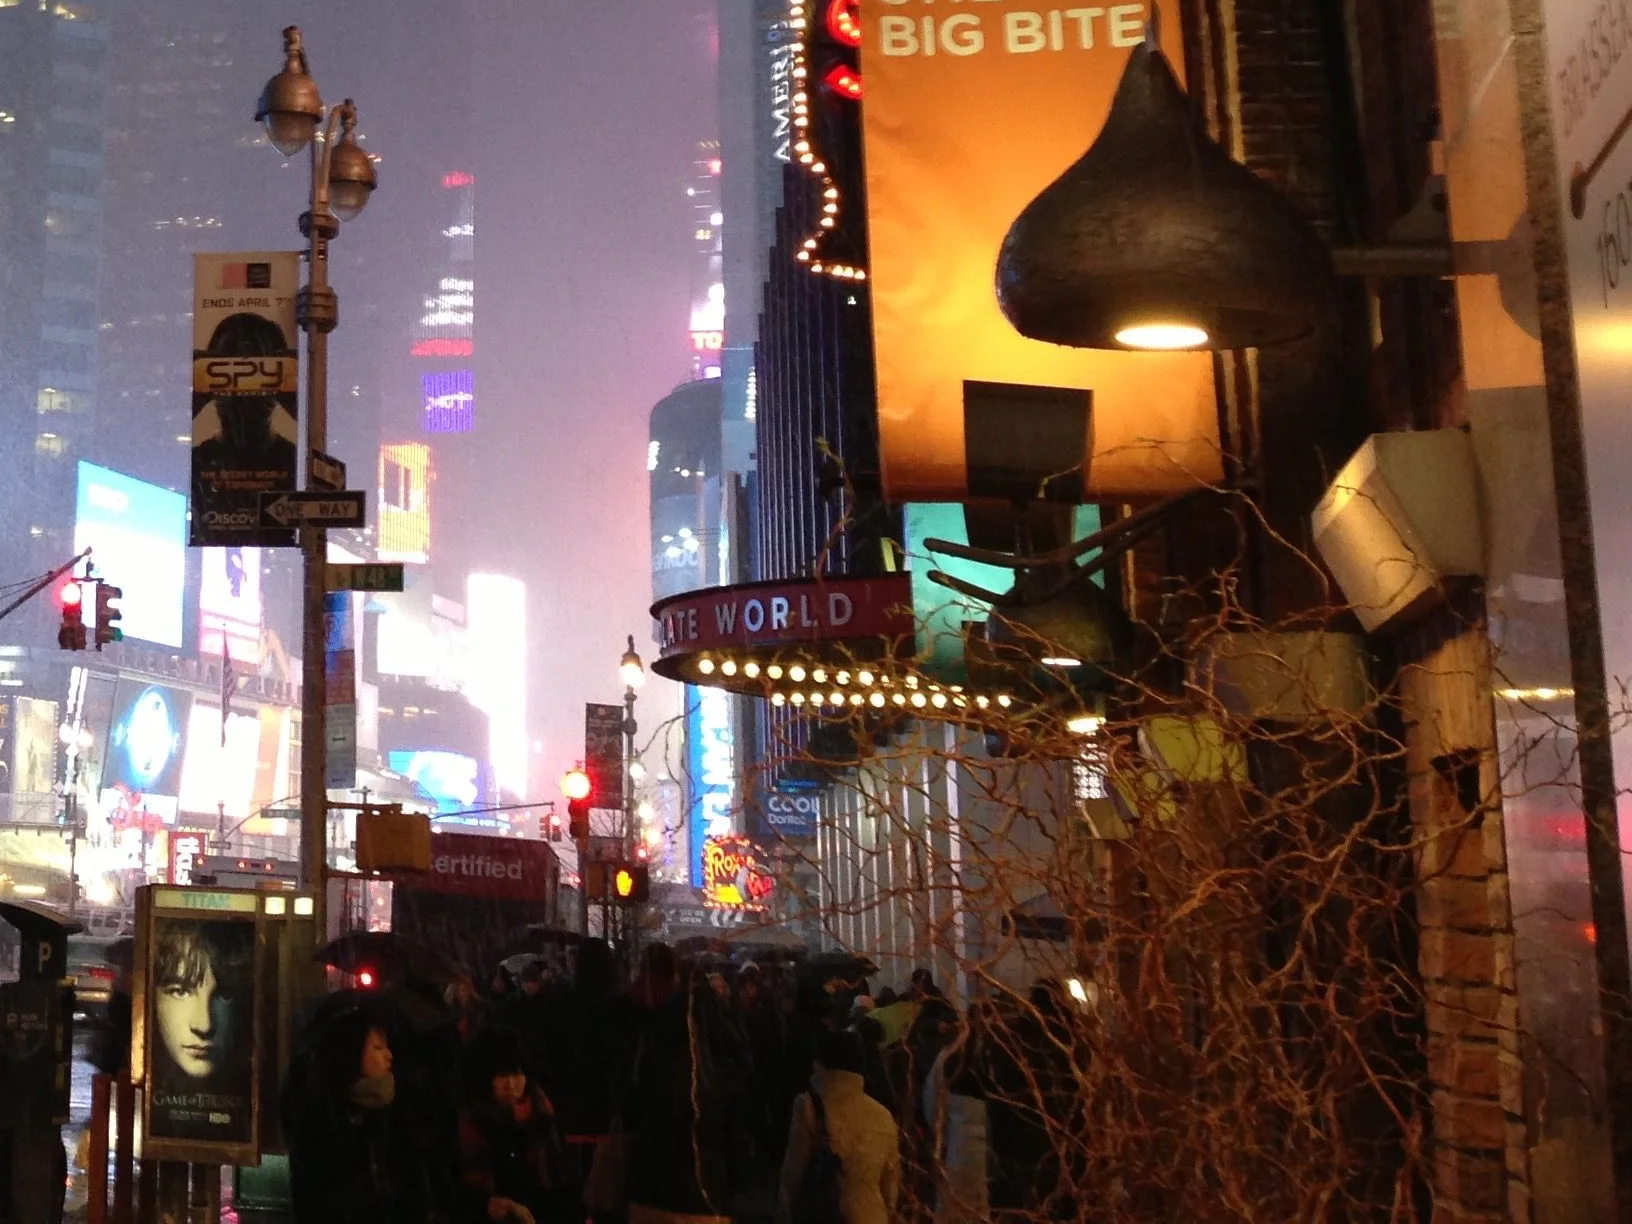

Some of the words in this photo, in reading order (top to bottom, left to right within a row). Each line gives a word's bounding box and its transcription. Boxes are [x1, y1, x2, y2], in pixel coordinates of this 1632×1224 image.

[879, 14, 982, 57] BIG
[1003, 4, 1146, 56] BITE
[202, 298, 234, 309] ENDS
[238, 297, 271, 309] APRIL
[206, 361, 284, 389] SPY
[207, 510, 257, 524] DISCOV
[275, 502, 304, 517] ONE
[319, 502, 352, 516] WAY
[715, 592, 853, 635] WORLD
[430, 855, 522, 880] ertified
[153, 1091, 188, 1106] GAME
